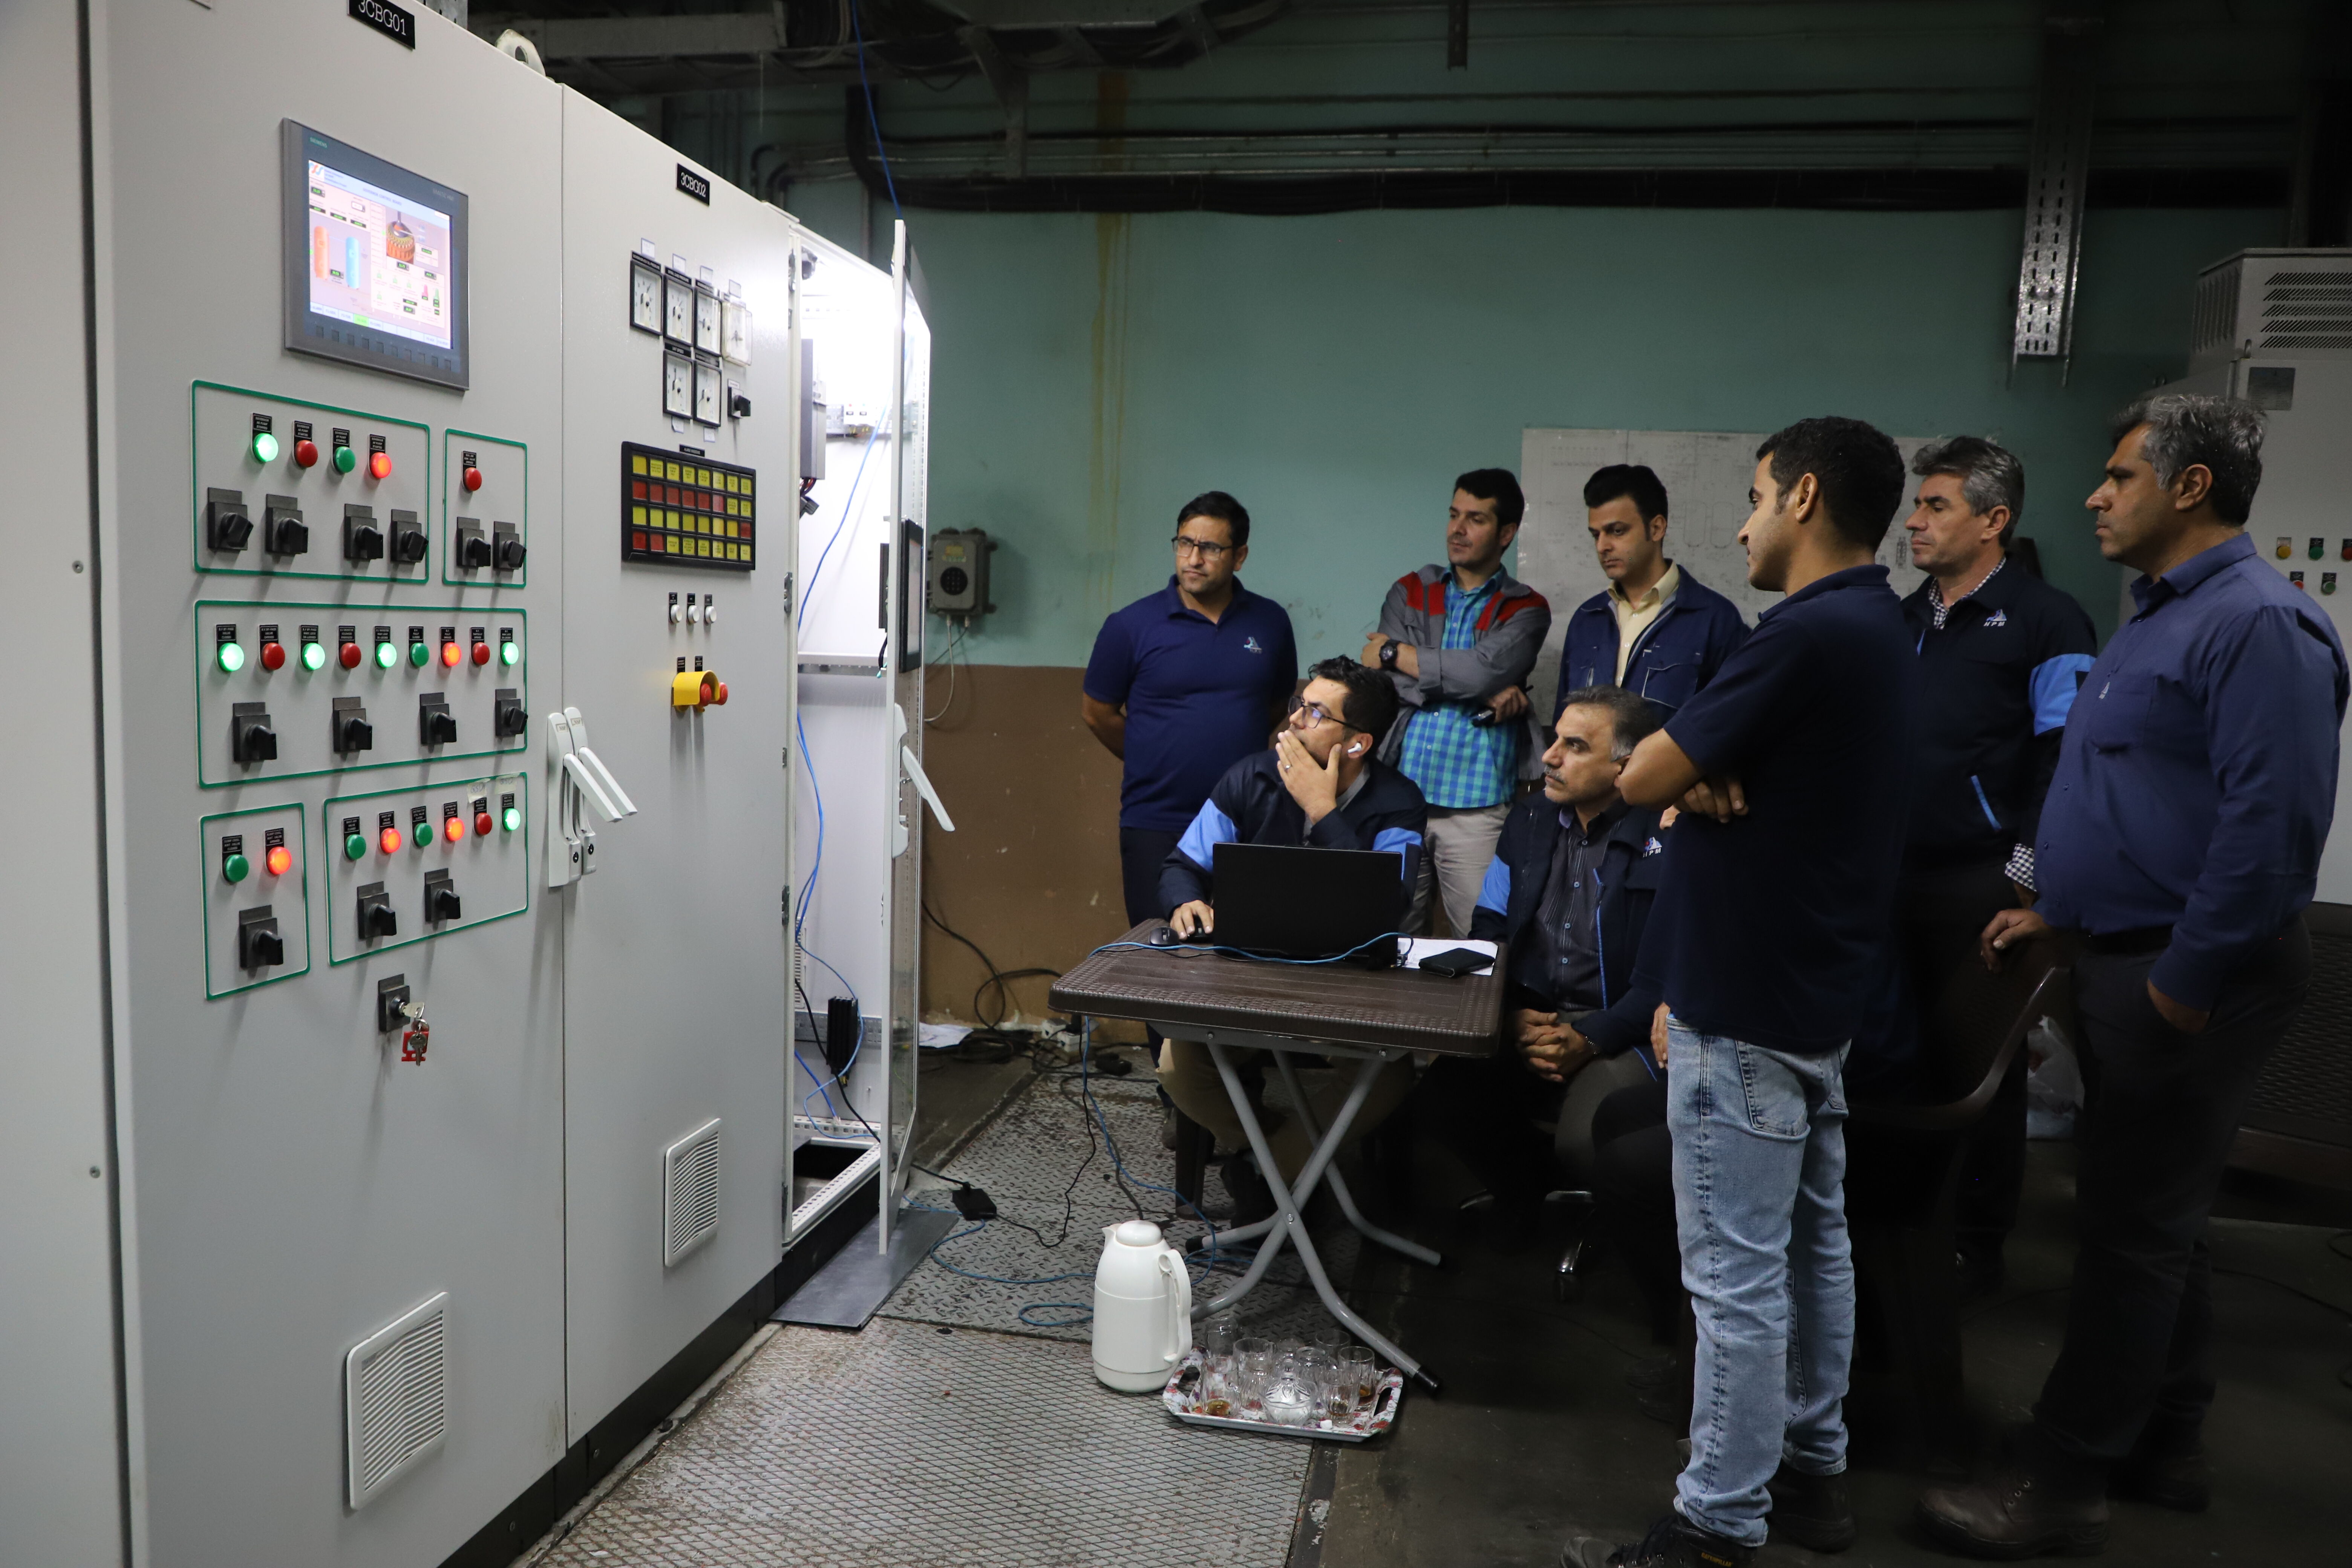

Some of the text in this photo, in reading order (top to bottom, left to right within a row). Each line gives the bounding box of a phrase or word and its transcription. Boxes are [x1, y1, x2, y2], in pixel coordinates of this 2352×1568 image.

[358, 0, 406, 35] 3CBG01
[310, 137, 327, 148] SIEMENS
[681, 172, 706, 198] 3CBG02
[1643, 848, 1661, 858] HPM
